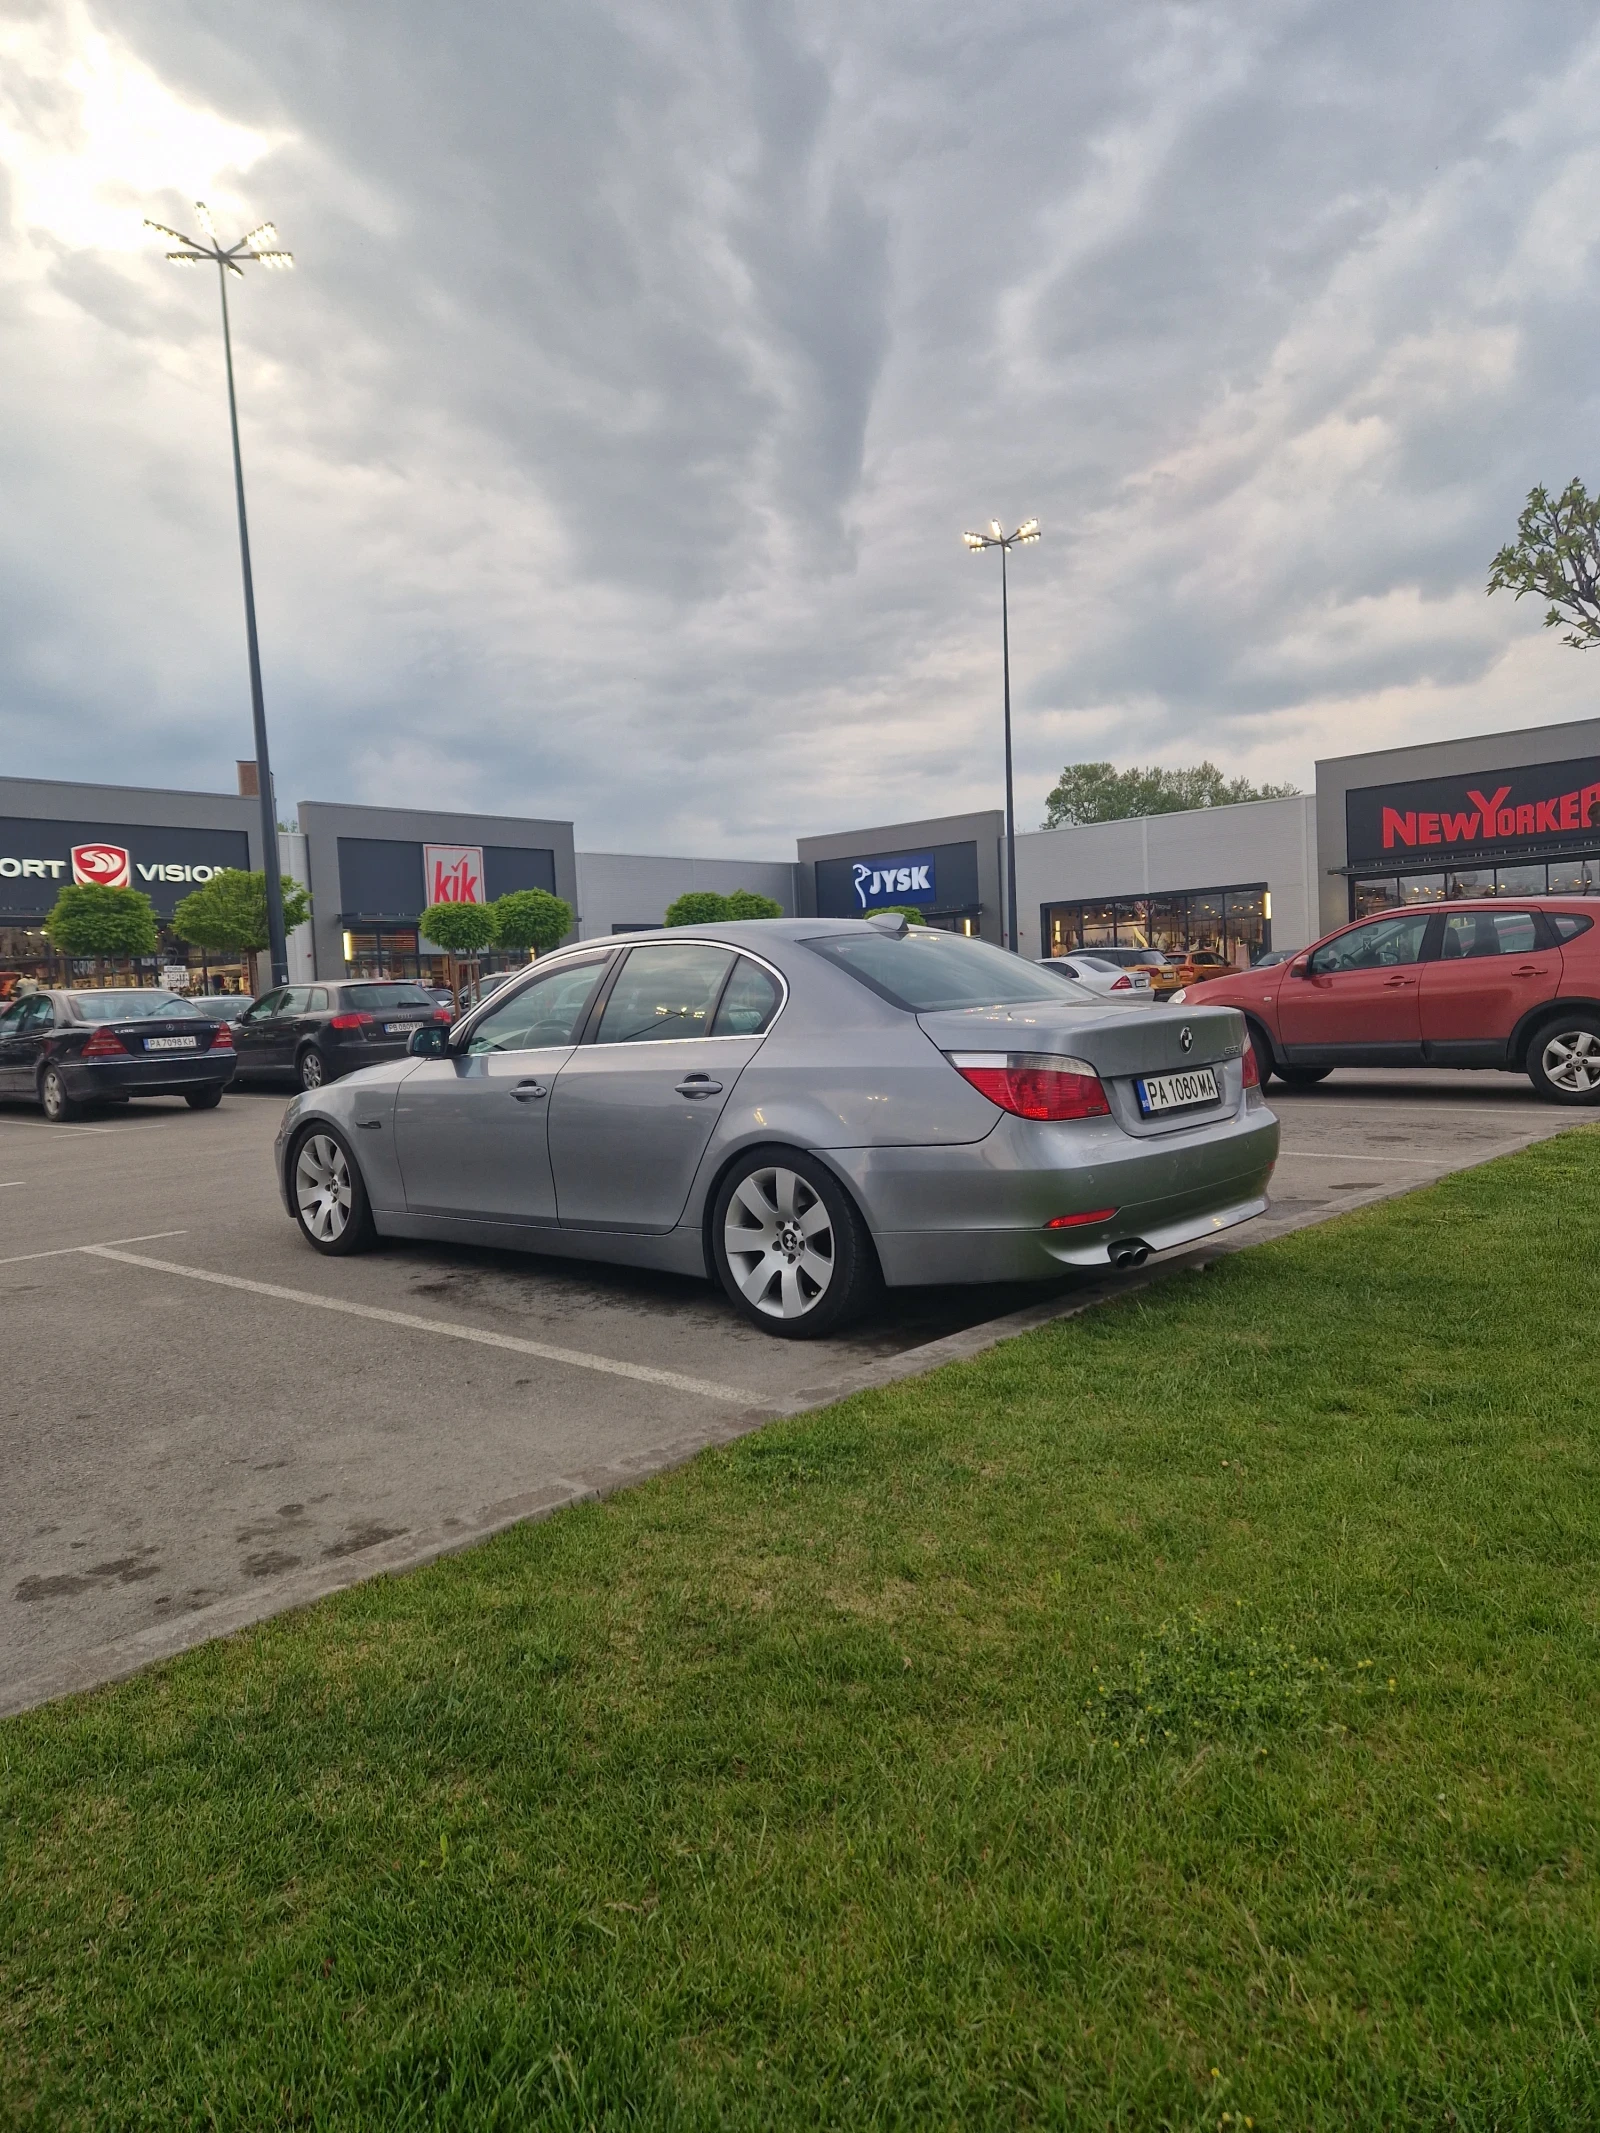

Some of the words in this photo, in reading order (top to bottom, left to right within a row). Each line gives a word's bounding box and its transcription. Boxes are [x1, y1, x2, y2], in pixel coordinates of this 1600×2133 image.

[869, 865, 932, 895] JYSK
[149, 1040, 161, 1048] PA
[163, 1039, 182, 1047] 7098
[1147, 1081, 1168, 1106] PA
[1169, 1075, 1199, 1102] 1080
[1197, 1073, 1215, 1097] MA
